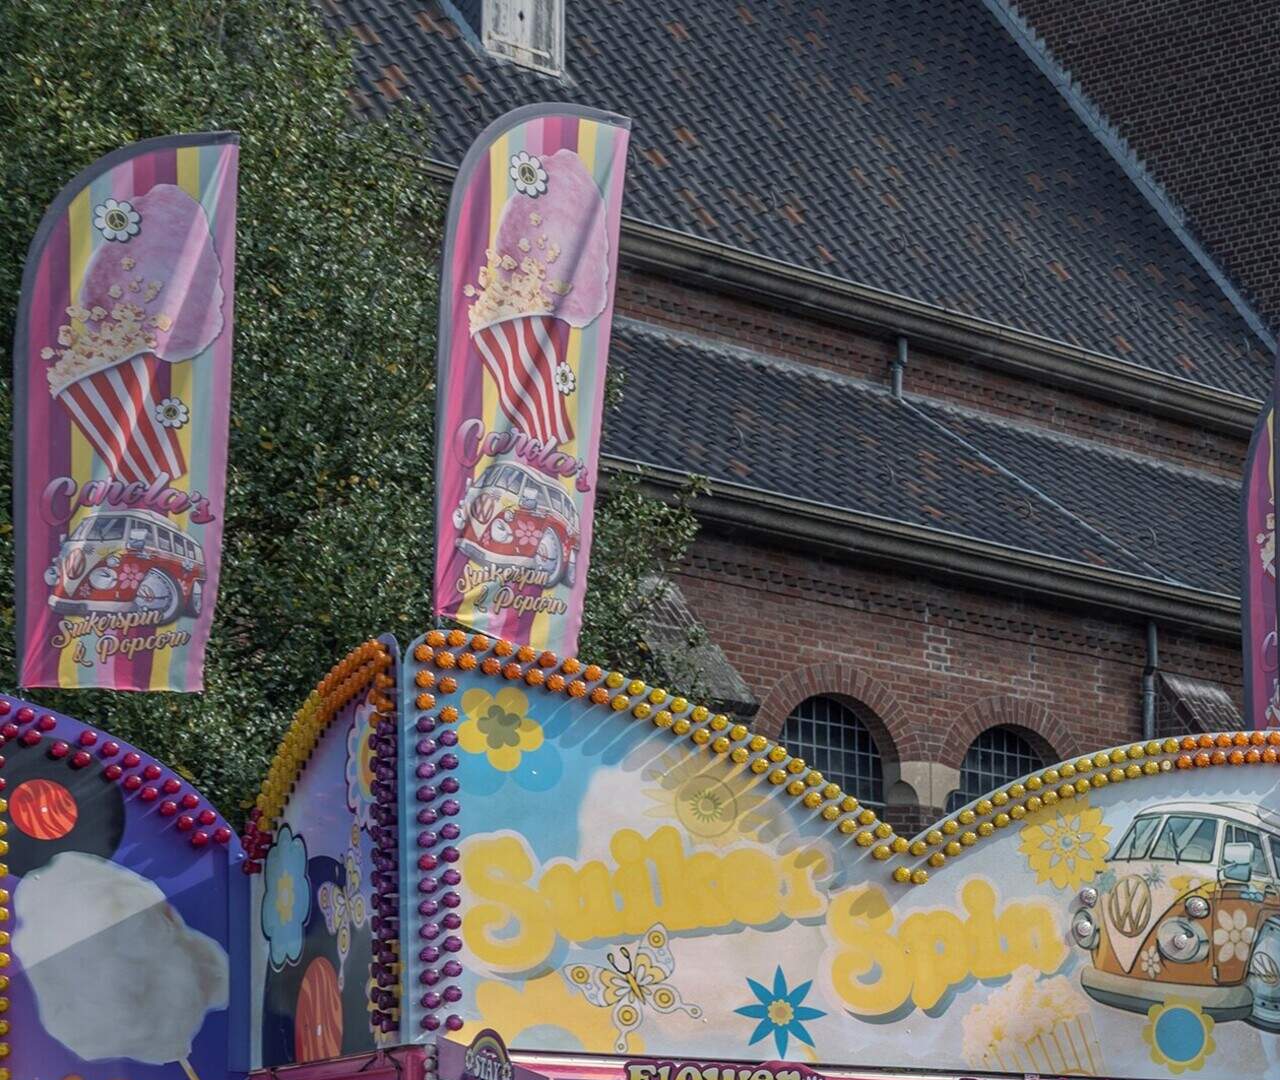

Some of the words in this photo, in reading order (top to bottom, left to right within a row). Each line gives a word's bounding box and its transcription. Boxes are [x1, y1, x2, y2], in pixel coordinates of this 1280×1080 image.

[455, 418, 591, 492] Carola's
[39, 472, 216, 526] Carola's
[456, 563, 551, 593] Suikerspin
[494, 586, 567, 614] Popcorn
[51, 607, 164, 648] Suikerspin
[96, 630, 192, 664] Popcorn
[826, 880, 1068, 1012] Spin
